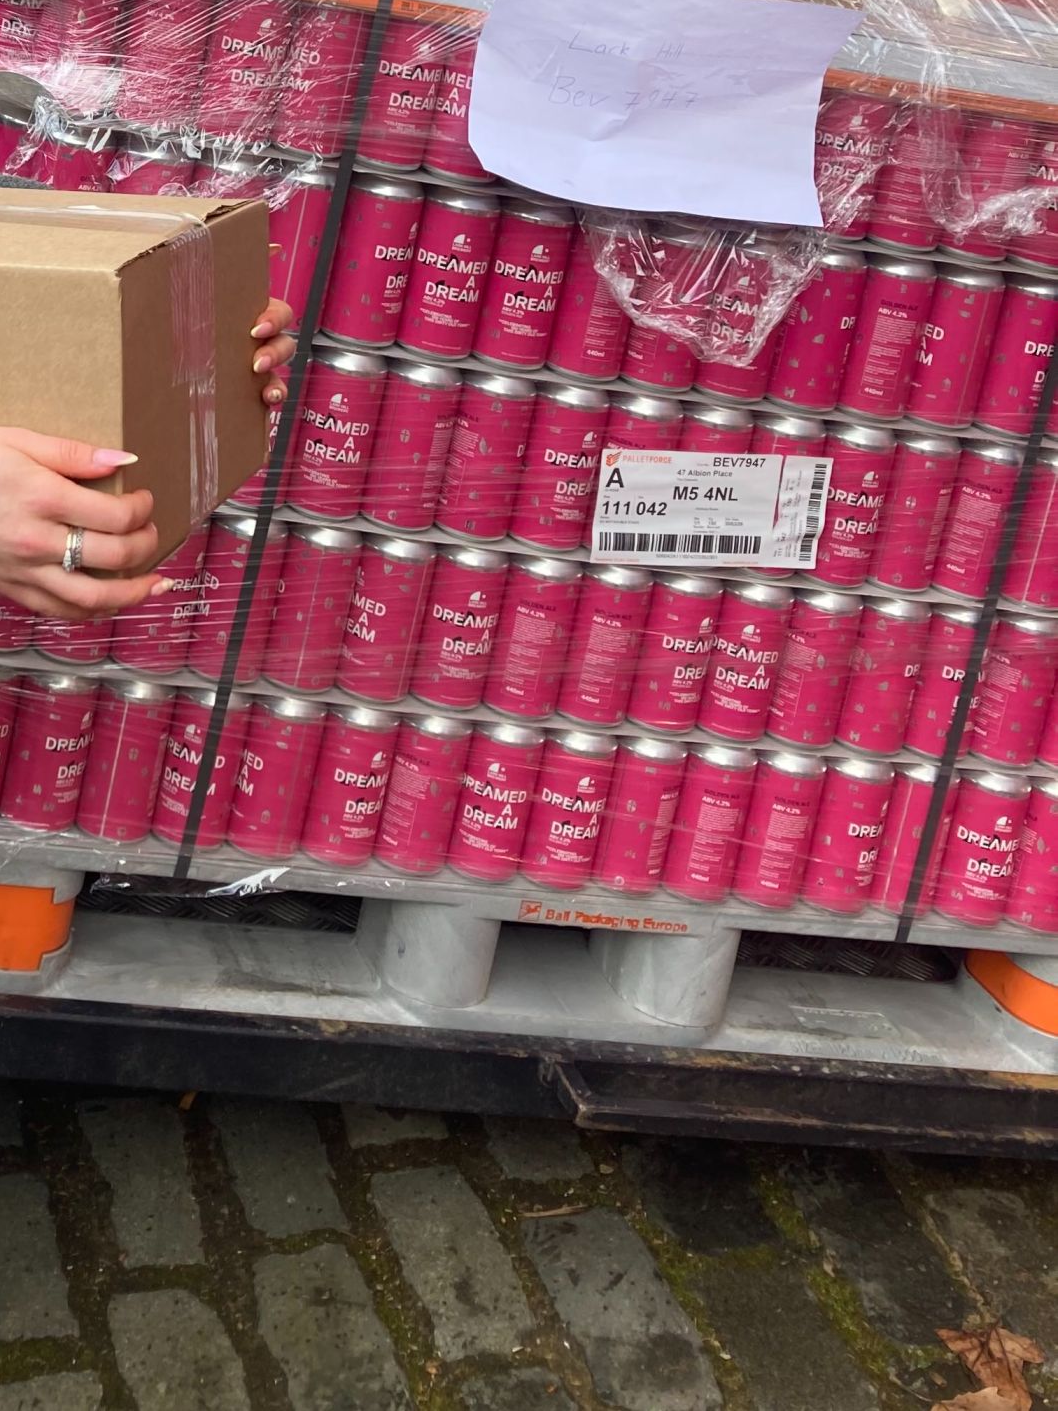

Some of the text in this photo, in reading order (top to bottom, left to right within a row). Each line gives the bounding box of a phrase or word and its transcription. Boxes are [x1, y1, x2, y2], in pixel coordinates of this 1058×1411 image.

[448, 88, 459, 101] A
[417, 248, 487, 275] DREAMED
[495, 260, 563, 284] DREAMED
[465, 276, 475, 288] A
[425, 281, 480, 303] DREAM
[544, 286, 553, 298] A
[504, 293, 557, 312] DREAM
[712, 292, 759, 317] REAM
[920, 323, 944, 340] ED
[344, 436, 355, 449] A
[305, 439, 360, 464] DREAM
[623, 454, 767, 469] PALLETFORCE BEV7947
[605, 467, 625, 488] A
[687, 469, 712, 477] Albion
[713, 470, 733, 478] Place
[673, 486, 738, 502] M5 4NL
[602, 500, 668, 517] 111 042
[517, 606, 529, 614] ABV
[358, 612, 369, 627] A
[592, 615, 605, 624] ABV
[345, 619, 376, 644] EAM
[481, 629, 490, 642] A
[715, 666, 770, 690] DREAM
[755, 665, 765, 677] A
[702, 796, 715, 804] ABV
[772, 803, 785, 811] ABV
[464, 804, 518, 830] DREAM
[502, 804, 512, 816] A
[589, 814, 597, 826] A
[551, 821, 600, 840] DREAM
[1005, 852, 1013, 864] A
[545, 908, 688, 933] Ball Packaging Europe
